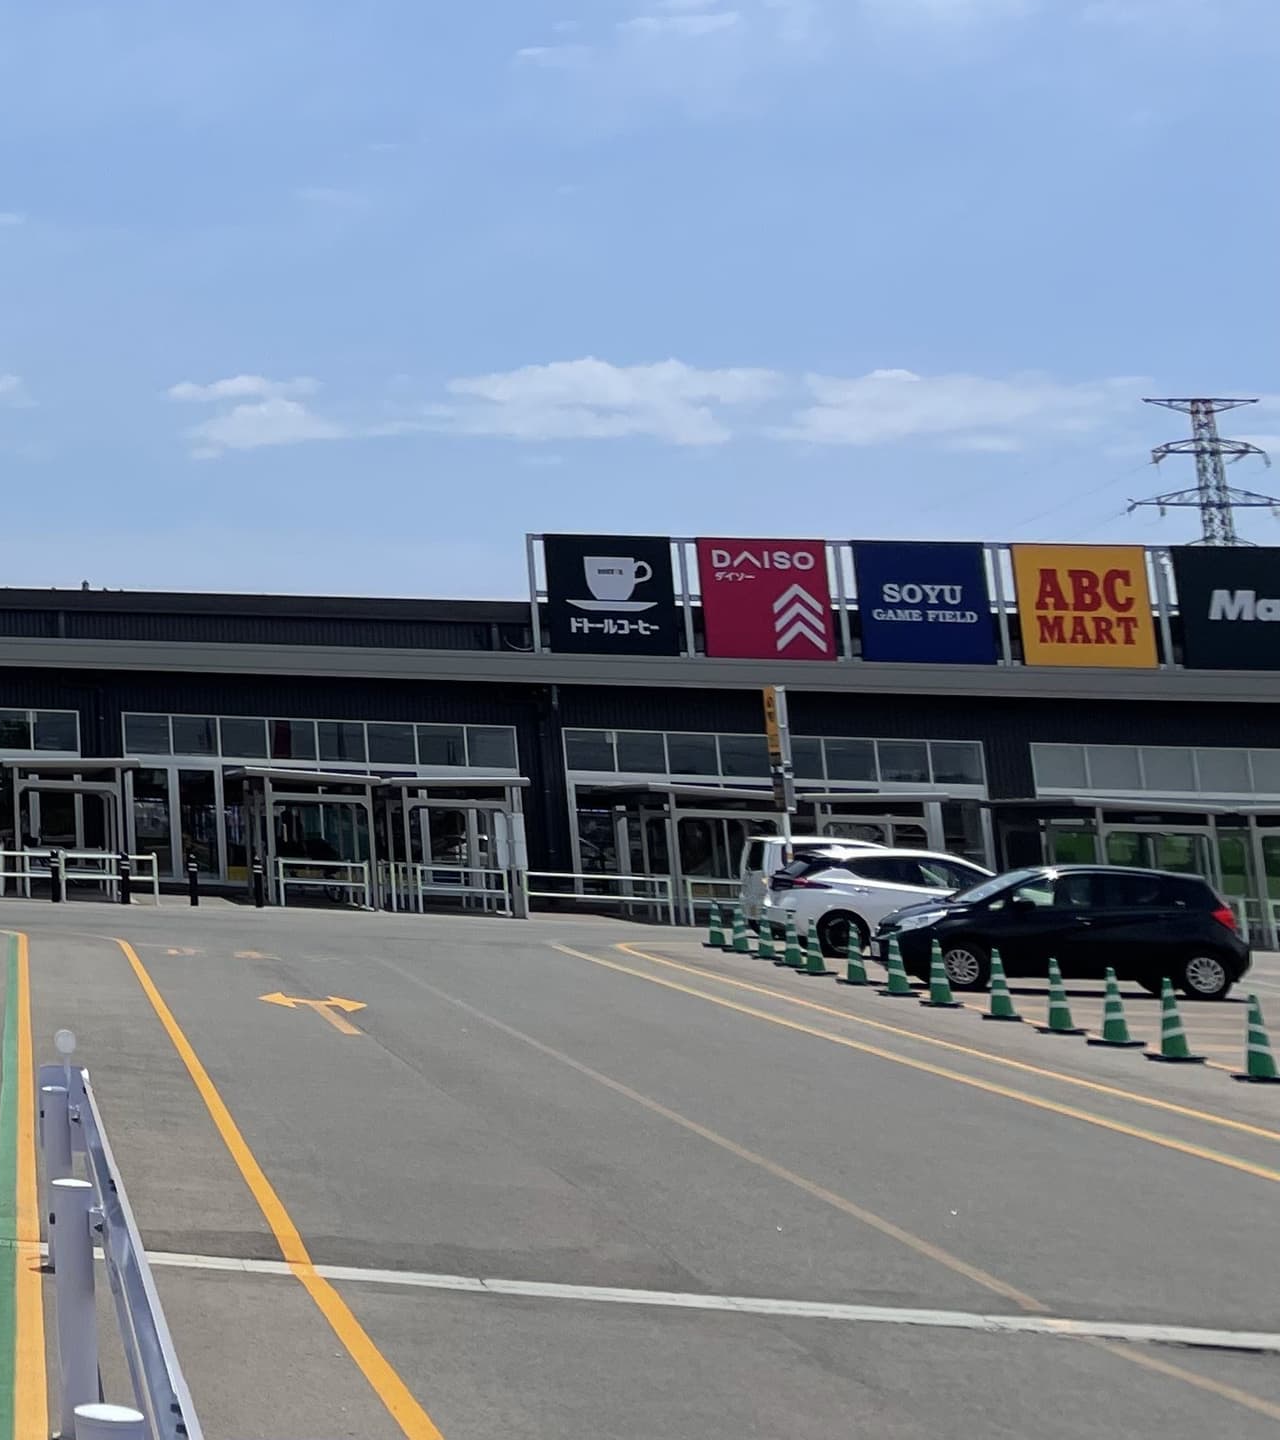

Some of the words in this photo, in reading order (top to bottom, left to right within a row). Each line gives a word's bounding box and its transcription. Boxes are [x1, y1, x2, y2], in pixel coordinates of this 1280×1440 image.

[711, 549, 815, 570] DAISO
[715, 571, 756, 581] ダイソー
[882, 583, 962, 605] SOYU
[1035, 568, 1135, 613] ABC
[570, 617, 660, 635] ドトールコーヒー
[872, 609, 923, 621] GAME
[926, 610, 978, 623] FIELD
[1036, 615, 1139, 645] MART
